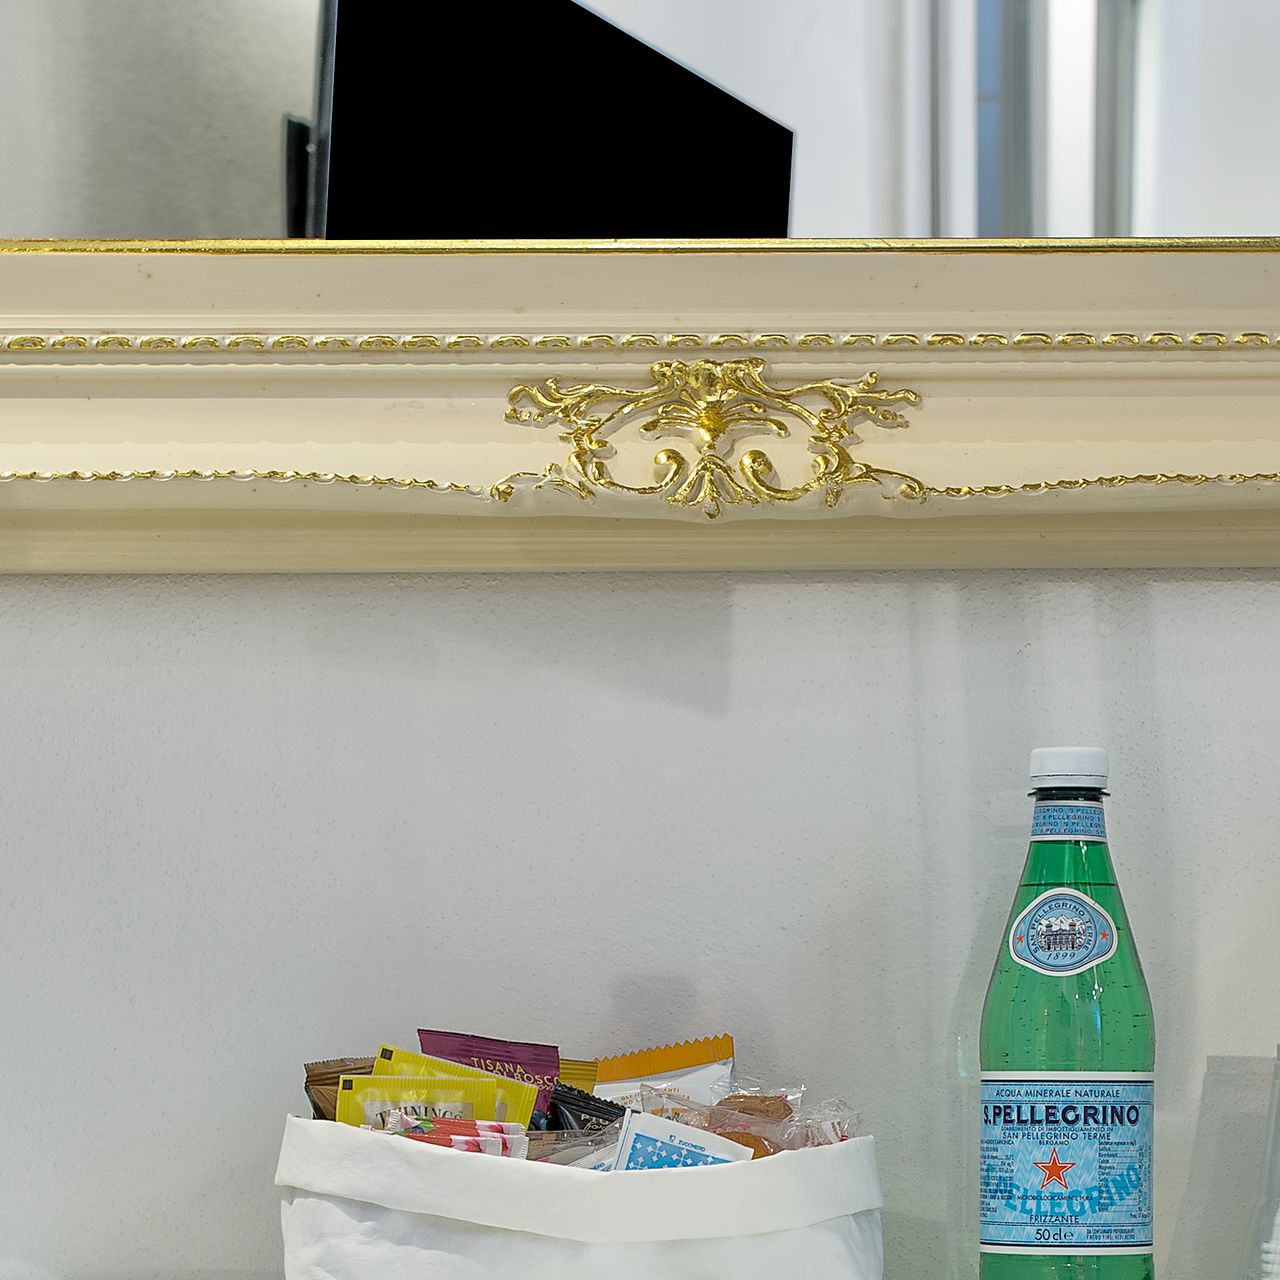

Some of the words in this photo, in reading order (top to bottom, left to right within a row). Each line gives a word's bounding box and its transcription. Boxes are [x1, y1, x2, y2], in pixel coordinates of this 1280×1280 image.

[1030, 902, 1086, 930] PELLEGRINO
[1082, 918, 1094, 952] TERME
[1030, 934, 1039, 954] SAN
[1046, 951, 1076, 961] 1899
[471, 1057, 526, 1075] TISANA
[995, 1088, 1022, 1098] ACQUA
[1025, 1089, 1071, 1098] MINERALE
[1074, 1089, 1120, 1098] NATURALE
[983, 1104, 1141, 1126] S.PELLEGRINO
[1002, 1132, 1019, 1140] SAN
[1021, 1132, 1079, 1140] PELLEGRINO
[1082, 1132, 1112, 1141] TERME
[1029, 1214, 1080, 1223] FRIZZANTE
[1034, 1229, 1051, 1241] 50
[1052, 1227, 1062, 1241] cl
